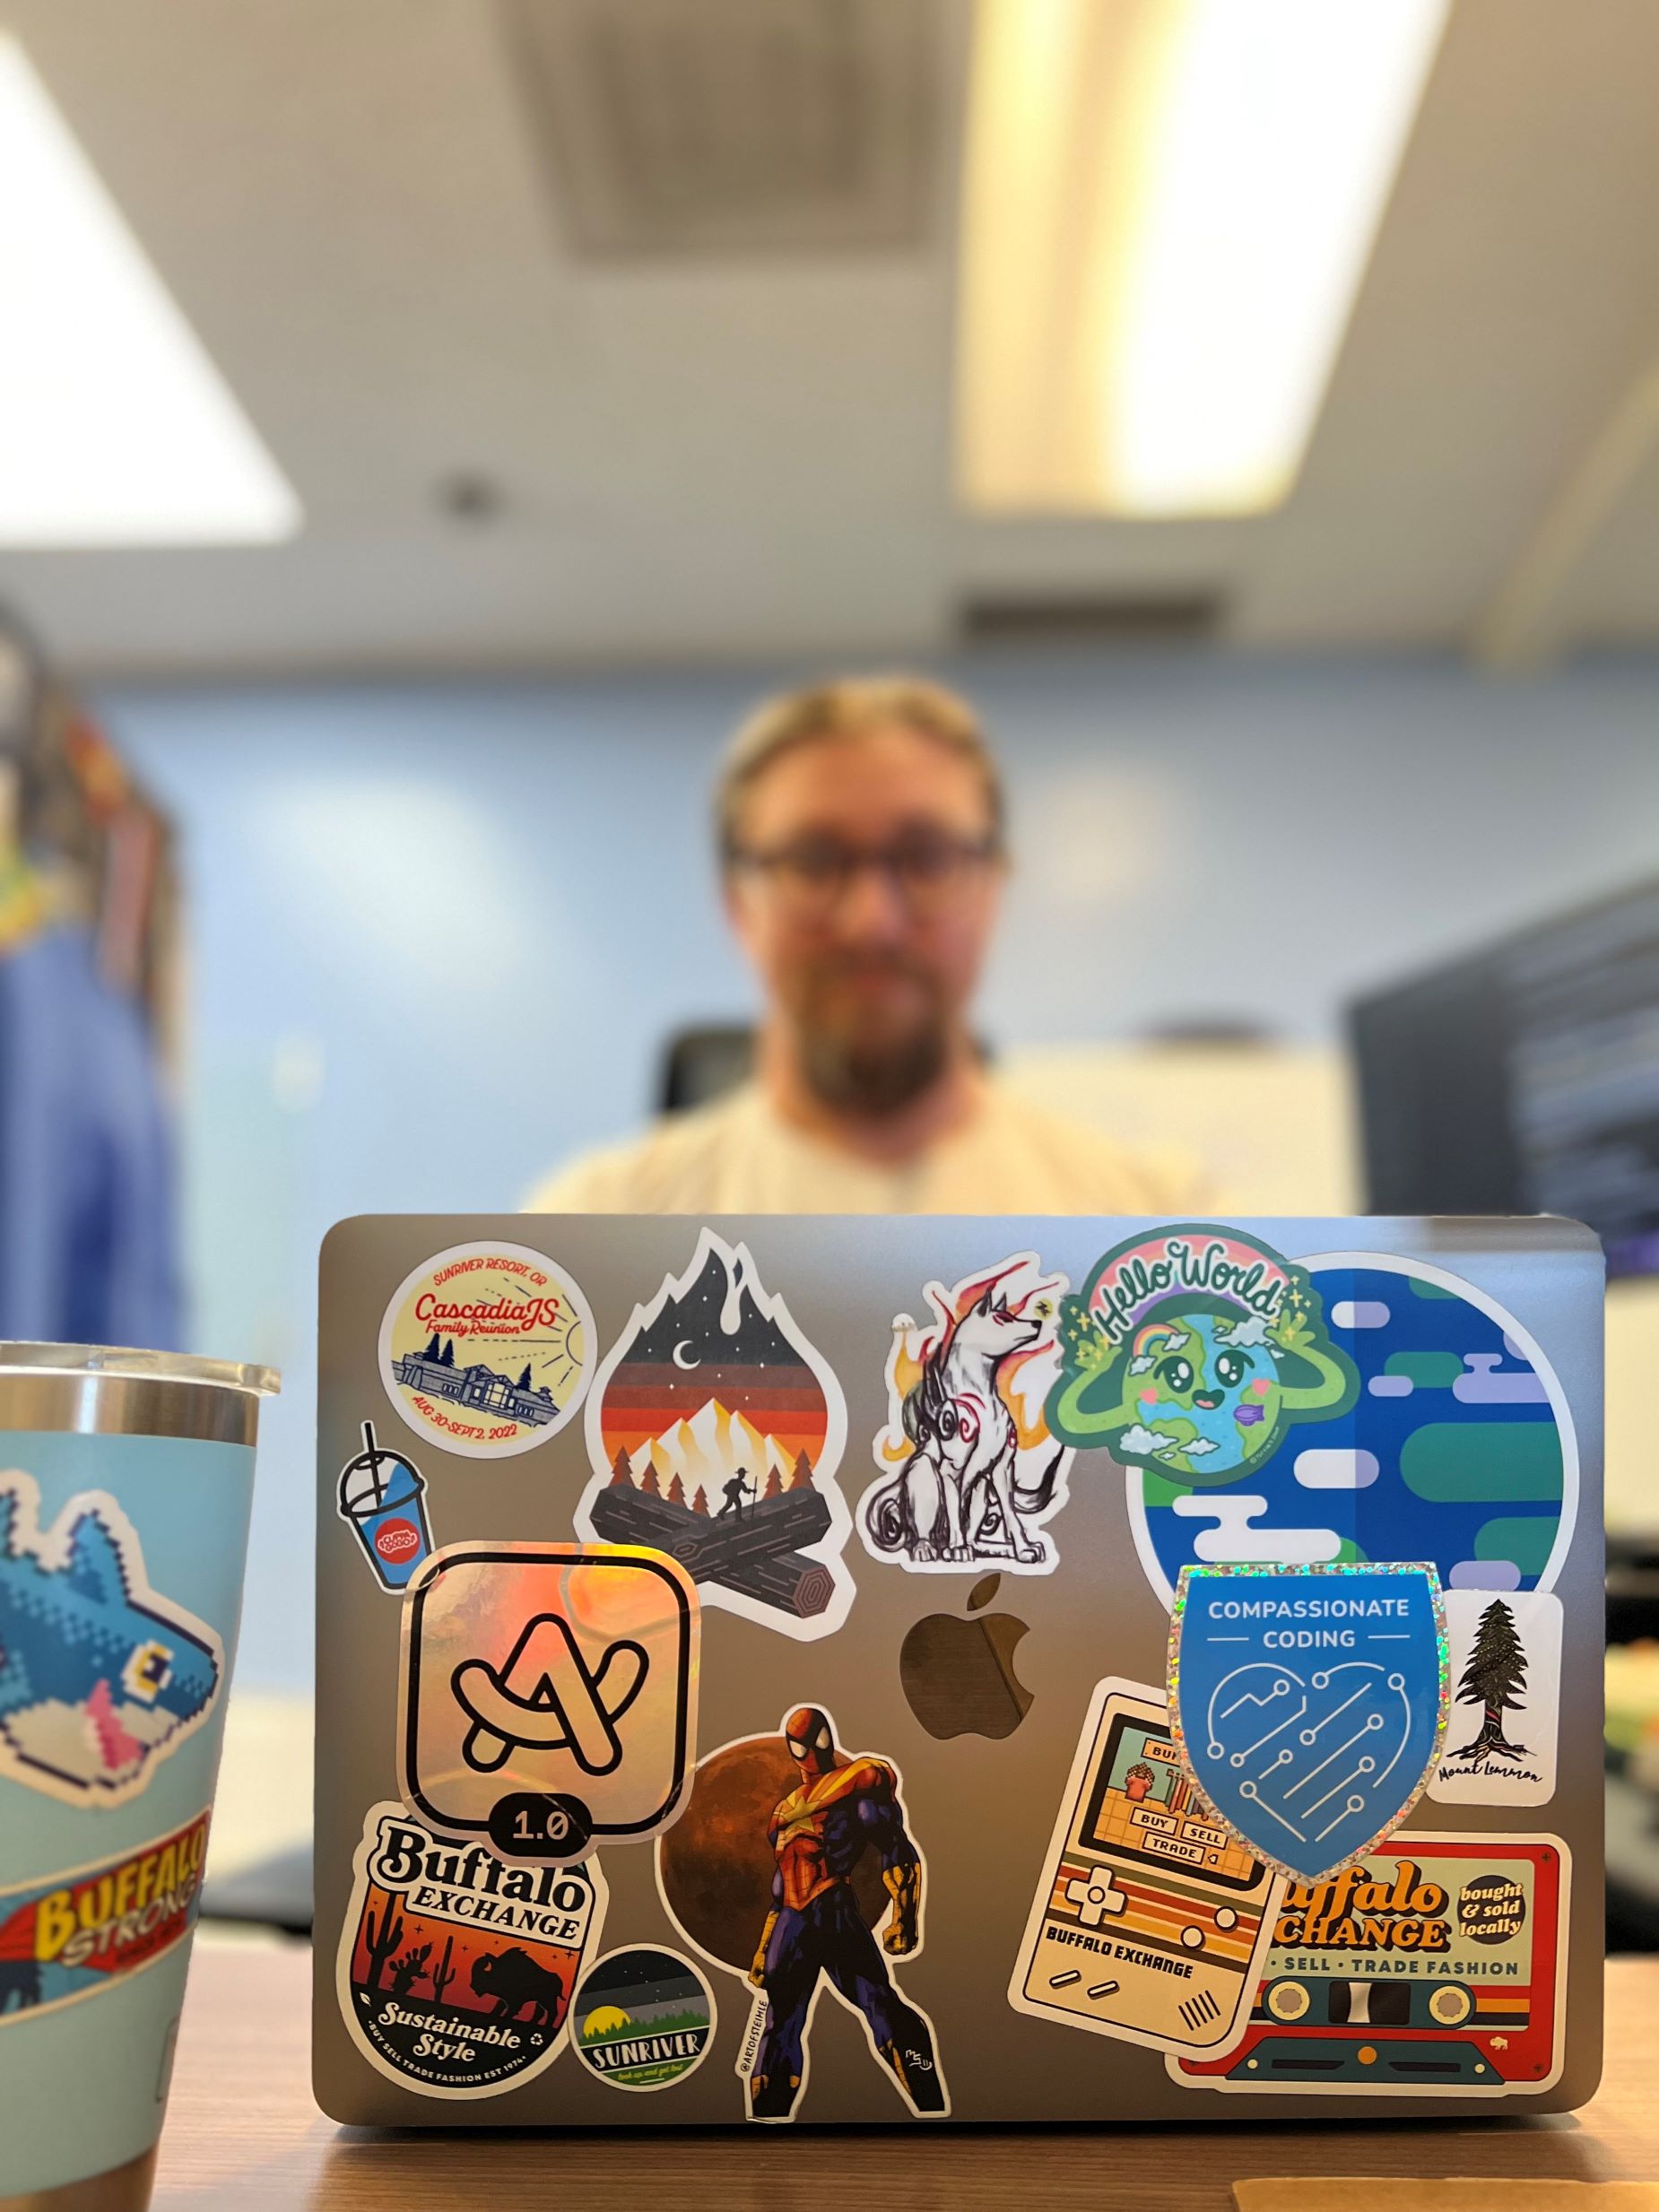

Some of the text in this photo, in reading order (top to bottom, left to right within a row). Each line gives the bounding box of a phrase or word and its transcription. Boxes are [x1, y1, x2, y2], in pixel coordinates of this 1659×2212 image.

[433, 1258, 548, 1287] SUNRIVER RESORT, OR
[1095, 1240, 1282, 1341] Hello World
[415, 1293, 560, 1332] CascadiaJS
[425, 1320, 520, 1337] Family Reunion
[412, 1396, 435, 1416] AUG
[488, 1423, 517, 1440] 2022
[1208, 1599, 1410, 1619] COMPASSIONATE
[1263, 1630, 1356, 1649] CODING
[1438, 1760, 1543, 1783] Mount Lemmon
[513, 1810, 569, 1841] 1.0
[1141, 1814, 1220, 1844] BUY SELL
[1152, 1838, 1197, 1859] TRADE
[35, 1822, 206, 1961] BUFFALO
[1281, 1861, 1446, 1919] uffalo
[1459, 1881, 1524, 1903] bought
[60, 1873, 196, 1966] STRONG
[413, 1886, 581, 1940] EXCHANGE
[1461, 1901, 1520, 1919] & sold
[1272, 1914, 1448, 1949] CHANGE
[1459, 1920, 1522, 1938] locally
[1046, 1925, 1194, 1980] BUFFALO EXCHANGE
[1284, 1956, 1519, 1975] SELL TRADE FASHION
[378, 2002, 522, 2049] Sustainable
[369, 2023, 386, 2043] BUY
[382, 2043, 401, 2062] SELL
[403, 2060, 434, 2078] TRADE
[436, 2073, 482, 2083] FASHION
[484, 2068, 502, 2079] EST
[413, 2034, 476, 2062] Style
[592, 2034, 701, 2069] SUNRIVER
